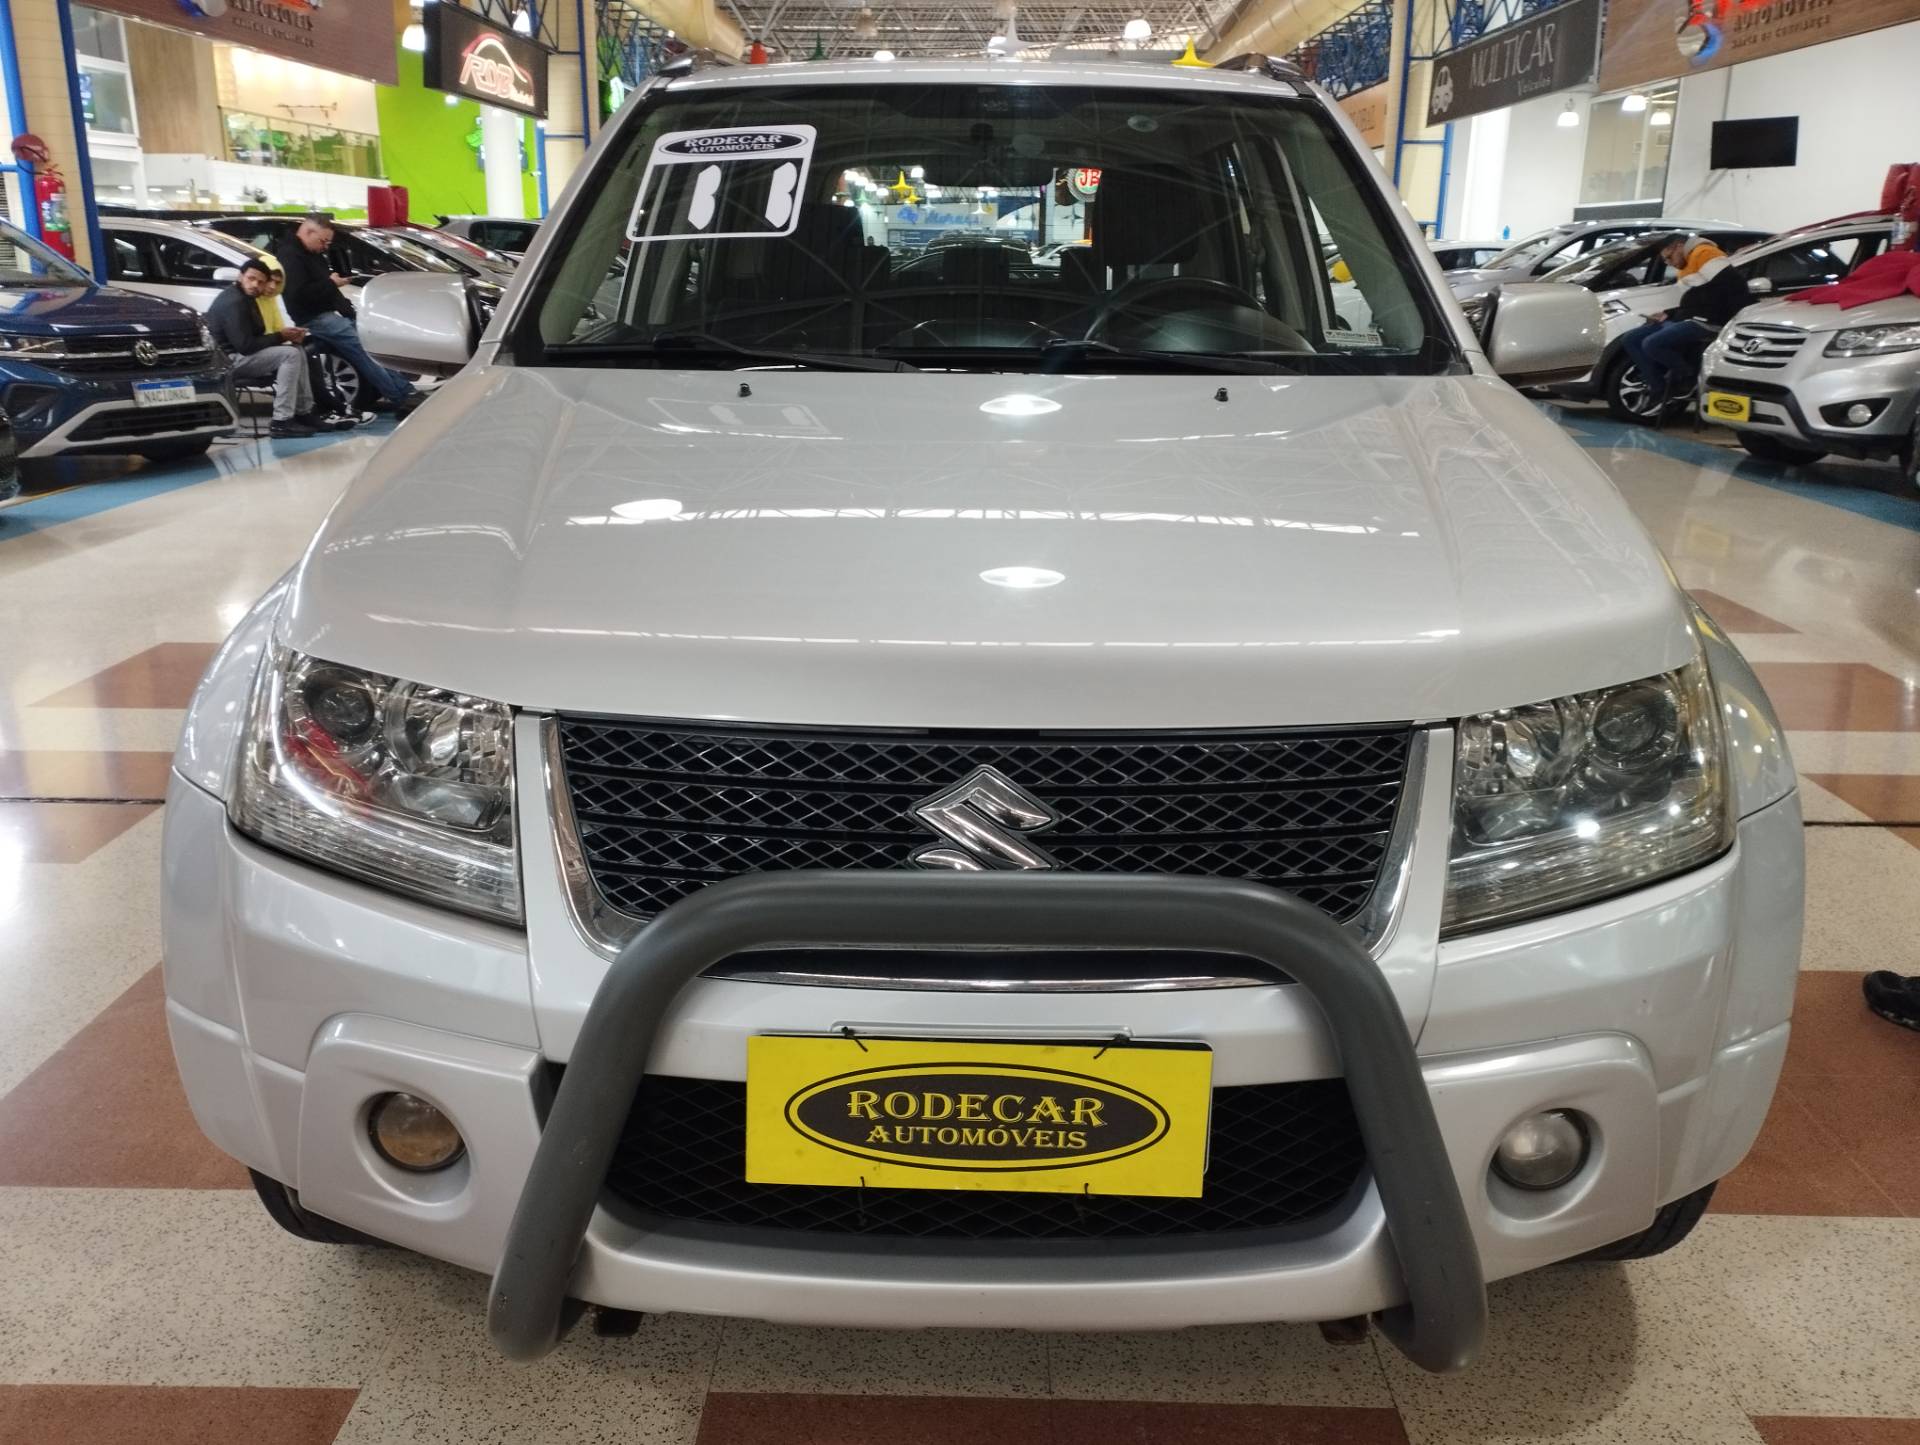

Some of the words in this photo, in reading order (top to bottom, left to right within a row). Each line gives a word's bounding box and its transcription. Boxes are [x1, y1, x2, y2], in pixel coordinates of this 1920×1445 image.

[1469, 23, 1556, 88] MULTICAR
[684, 133, 783, 147] RODECAR
[144, 387, 191, 404] NACIONAL
[847, 1090, 1108, 1128] RODECAR
[865, 1123, 1088, 1150] AUTOMÓVEIS
